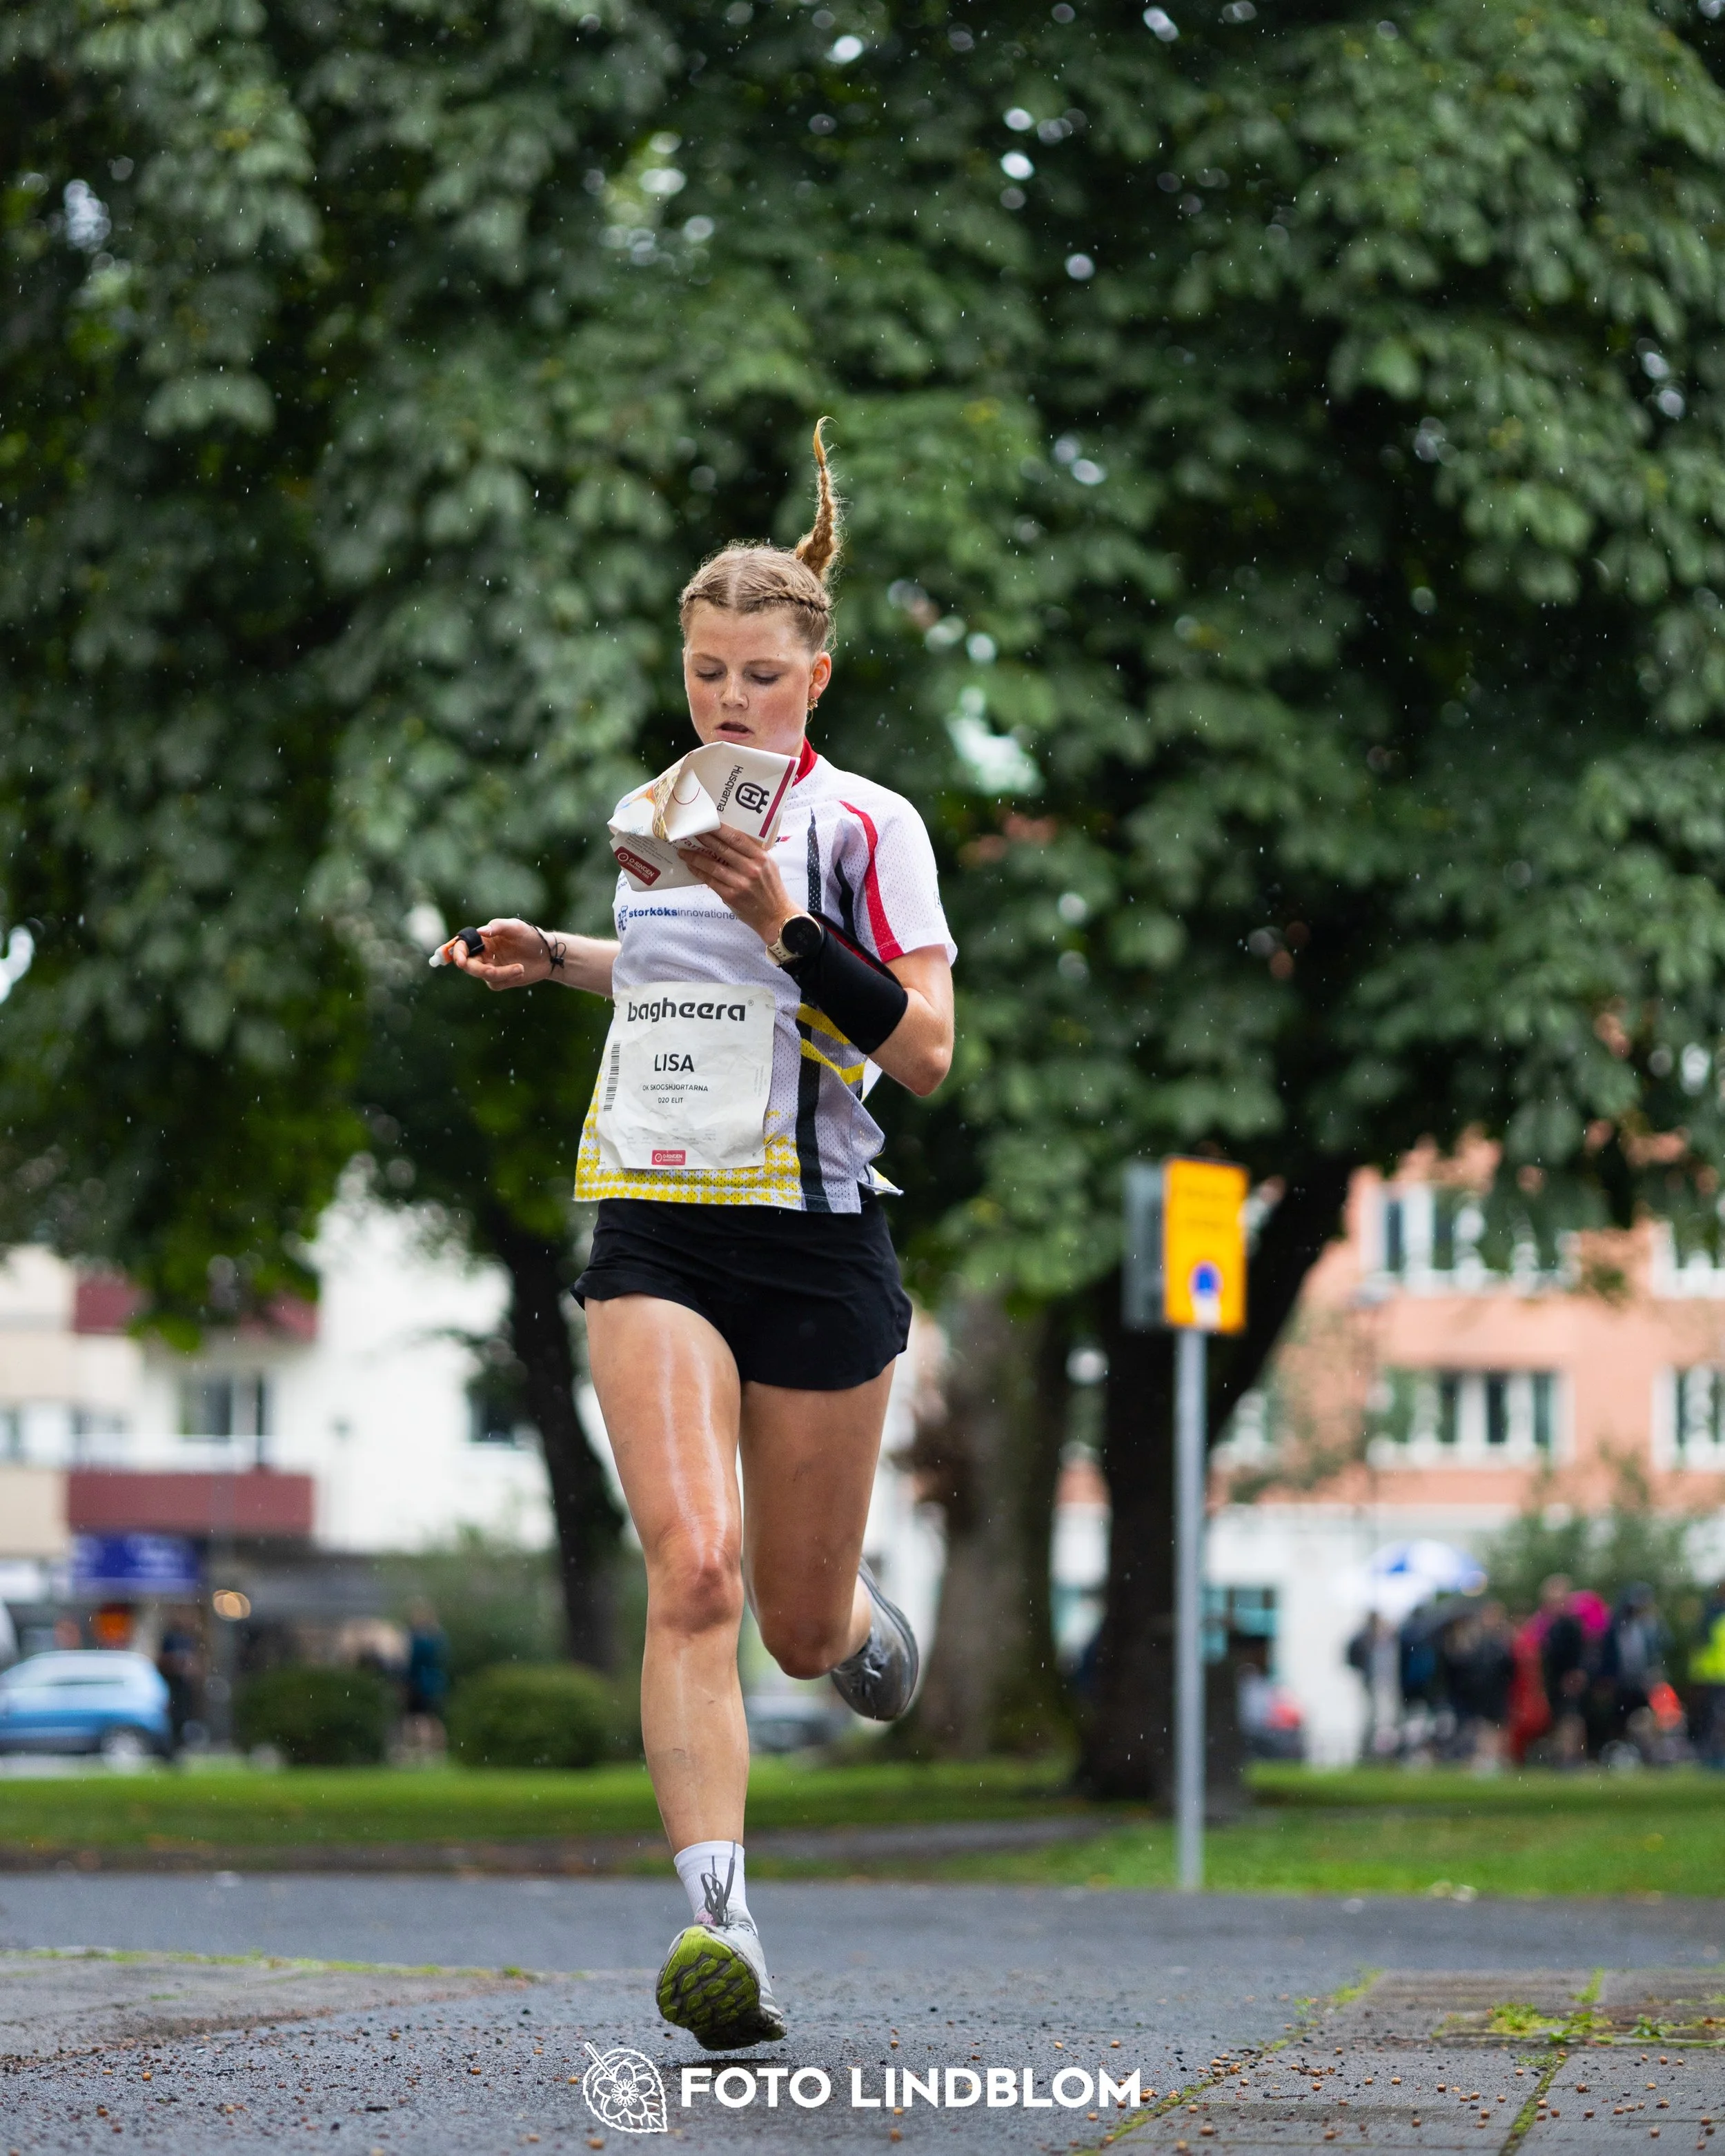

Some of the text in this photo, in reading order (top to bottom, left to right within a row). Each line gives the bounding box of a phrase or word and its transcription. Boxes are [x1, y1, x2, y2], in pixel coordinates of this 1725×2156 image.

[716, 764, 744, 812] Husqvarna
[629, 858, 655, 878] O-RINGEN
[629, 907, 741, 920] storköksinnovatione
[627, 997, 746, 1022] bagheera
[654, 1054, 695, 1072] LISA
[650, 1083, 709, 1091] SKOGSHJORTARNA
